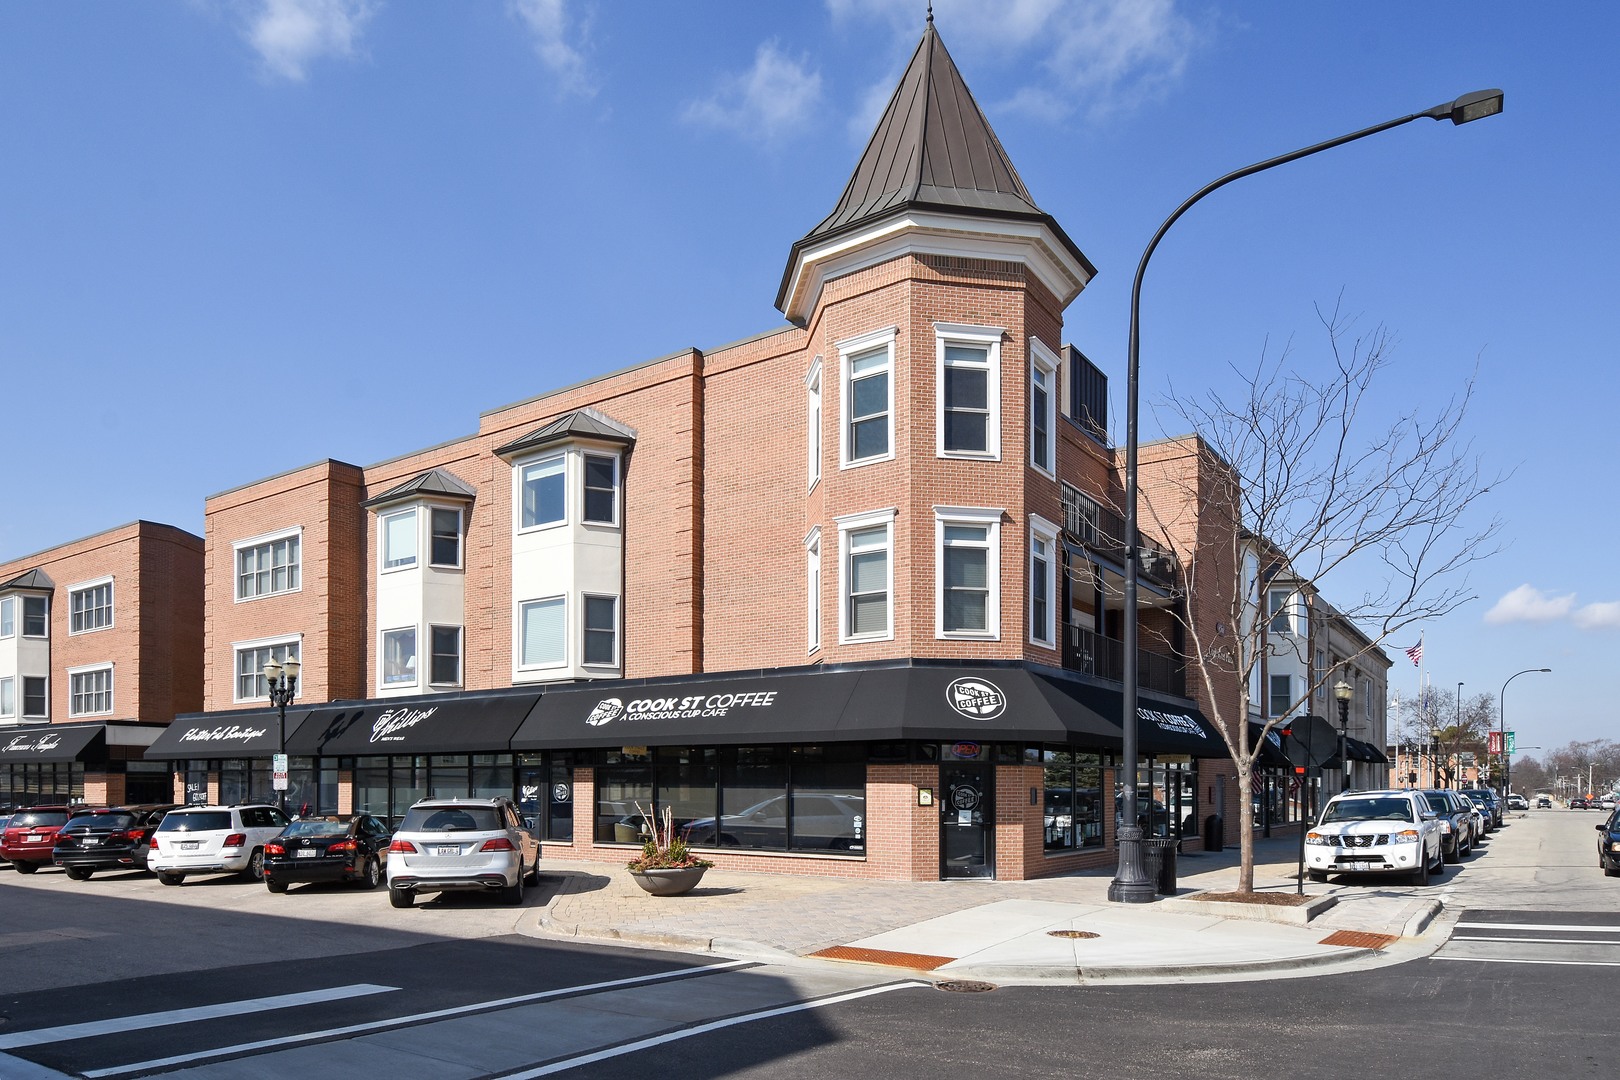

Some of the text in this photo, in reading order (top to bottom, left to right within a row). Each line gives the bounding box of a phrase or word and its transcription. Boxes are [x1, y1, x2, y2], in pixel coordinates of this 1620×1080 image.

[959, 687, 979, 697] COOK
[627, 691, 778, 713] COOK ST COFFEE
[960, 695, 998, 708] COFFEE
[589, 708, 619, 721] COFFEE
[619, 707, 729, 722] A CONSCIOUS CUP CAFE
[370, 707, 438, 742] Phillips
[952, 744, 980, 755] OPEN
